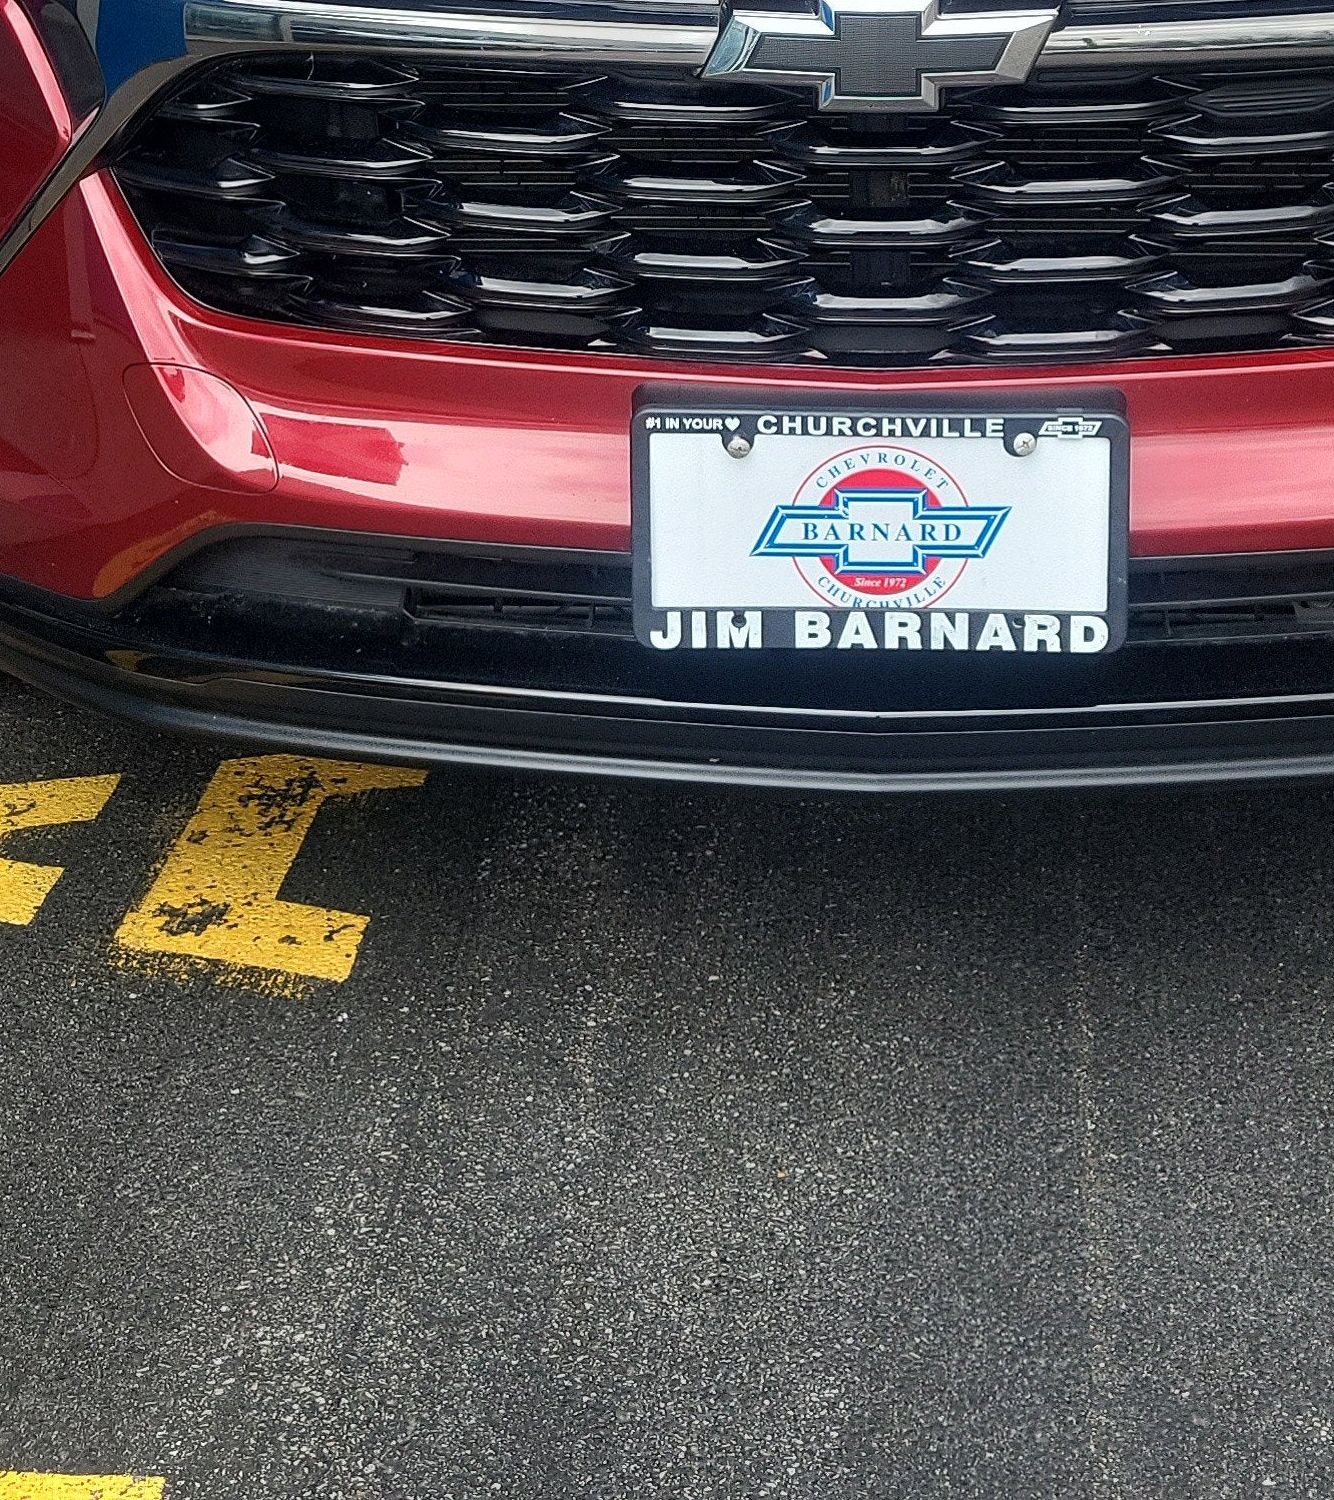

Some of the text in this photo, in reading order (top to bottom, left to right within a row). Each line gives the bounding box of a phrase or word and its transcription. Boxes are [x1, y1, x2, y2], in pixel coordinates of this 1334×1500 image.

[645, 416, 724, 430] #1 IN YOUR
[756, 415, 1005, 438] CHURCHVILLE
[816, 452, 949, 490] CHEVROLET
[801, 522, 962, 542] BARNARD
[853, 577, 907, 588] Since 1972
[649, 610, 1109, 654] JIM BARNARD
